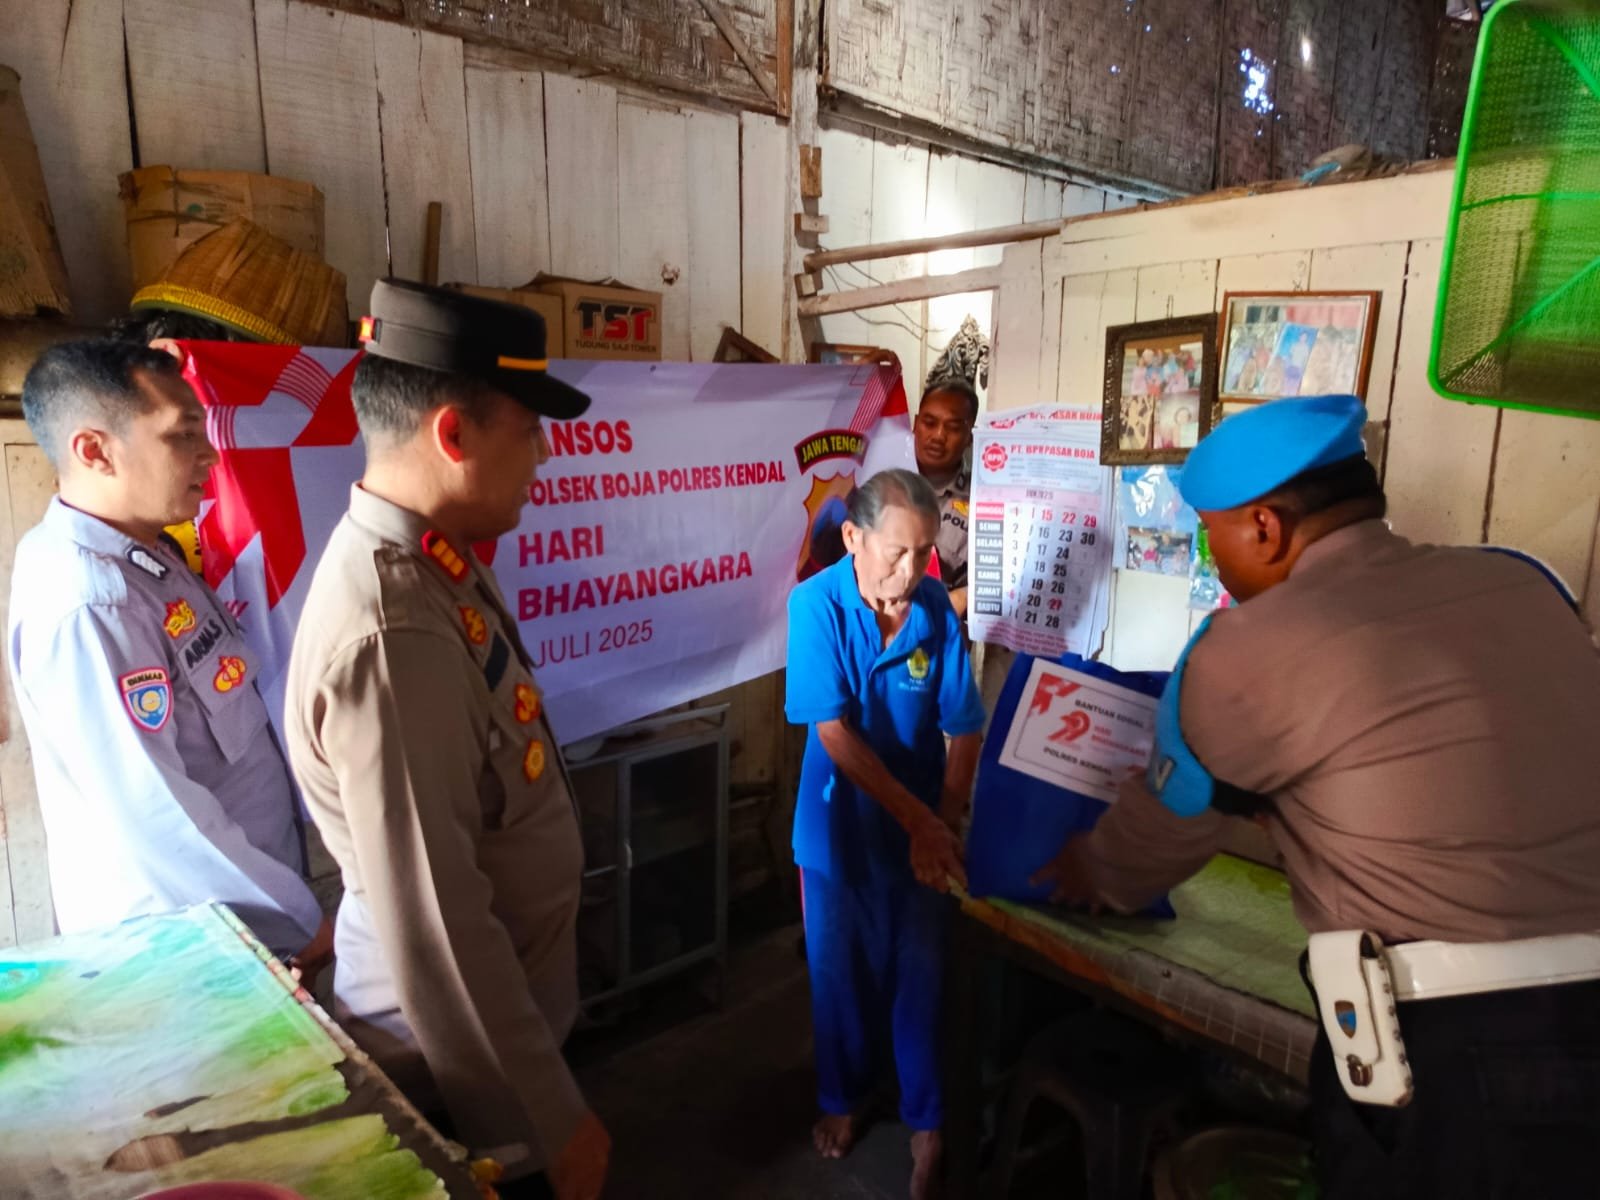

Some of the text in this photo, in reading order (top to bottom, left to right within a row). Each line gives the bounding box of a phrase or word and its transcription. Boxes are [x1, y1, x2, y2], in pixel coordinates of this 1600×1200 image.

[577, 302, 653, 341] TST
[802, 435, 866, 463] JAWA TENGA
[527, 460, 786, 508] OLSEK BOJA POLRES KENDAL
[1042, 510, 1053, 521] 15
[1062, 511, 1076, 525] 22
[1083, 515, 1097, 529] 29
[518, 525, 605, 568] HARI
[1038, 526, 1050, 539] 16
[1059, 529, 1073, 543] 23
[1080, 532, 1095, 546] 30
[1038, 544, 1048, 556] 17
[1056, 546, 1070, 560] 24
[1034, 561, 1046, 574] 18
[1053, 563, 1068, 577] 25
[518, 551, 753, 622] BHAYANGKARA
[1031, 578, 1044, 591] 19
[1051, 580, 1065, 595] 26
[976, 587, 1001, 598] JUMAT
[1026, 593, 1041, 608] 20
[1050, 598, 1063, 611] 27
[1024, 610, 1037, 625] 21
[1045, 614, 1060, 629] 28
[535, 619, 654, 669] JULI 2025
[1075, 699, 1115, 719] BANTUAN
